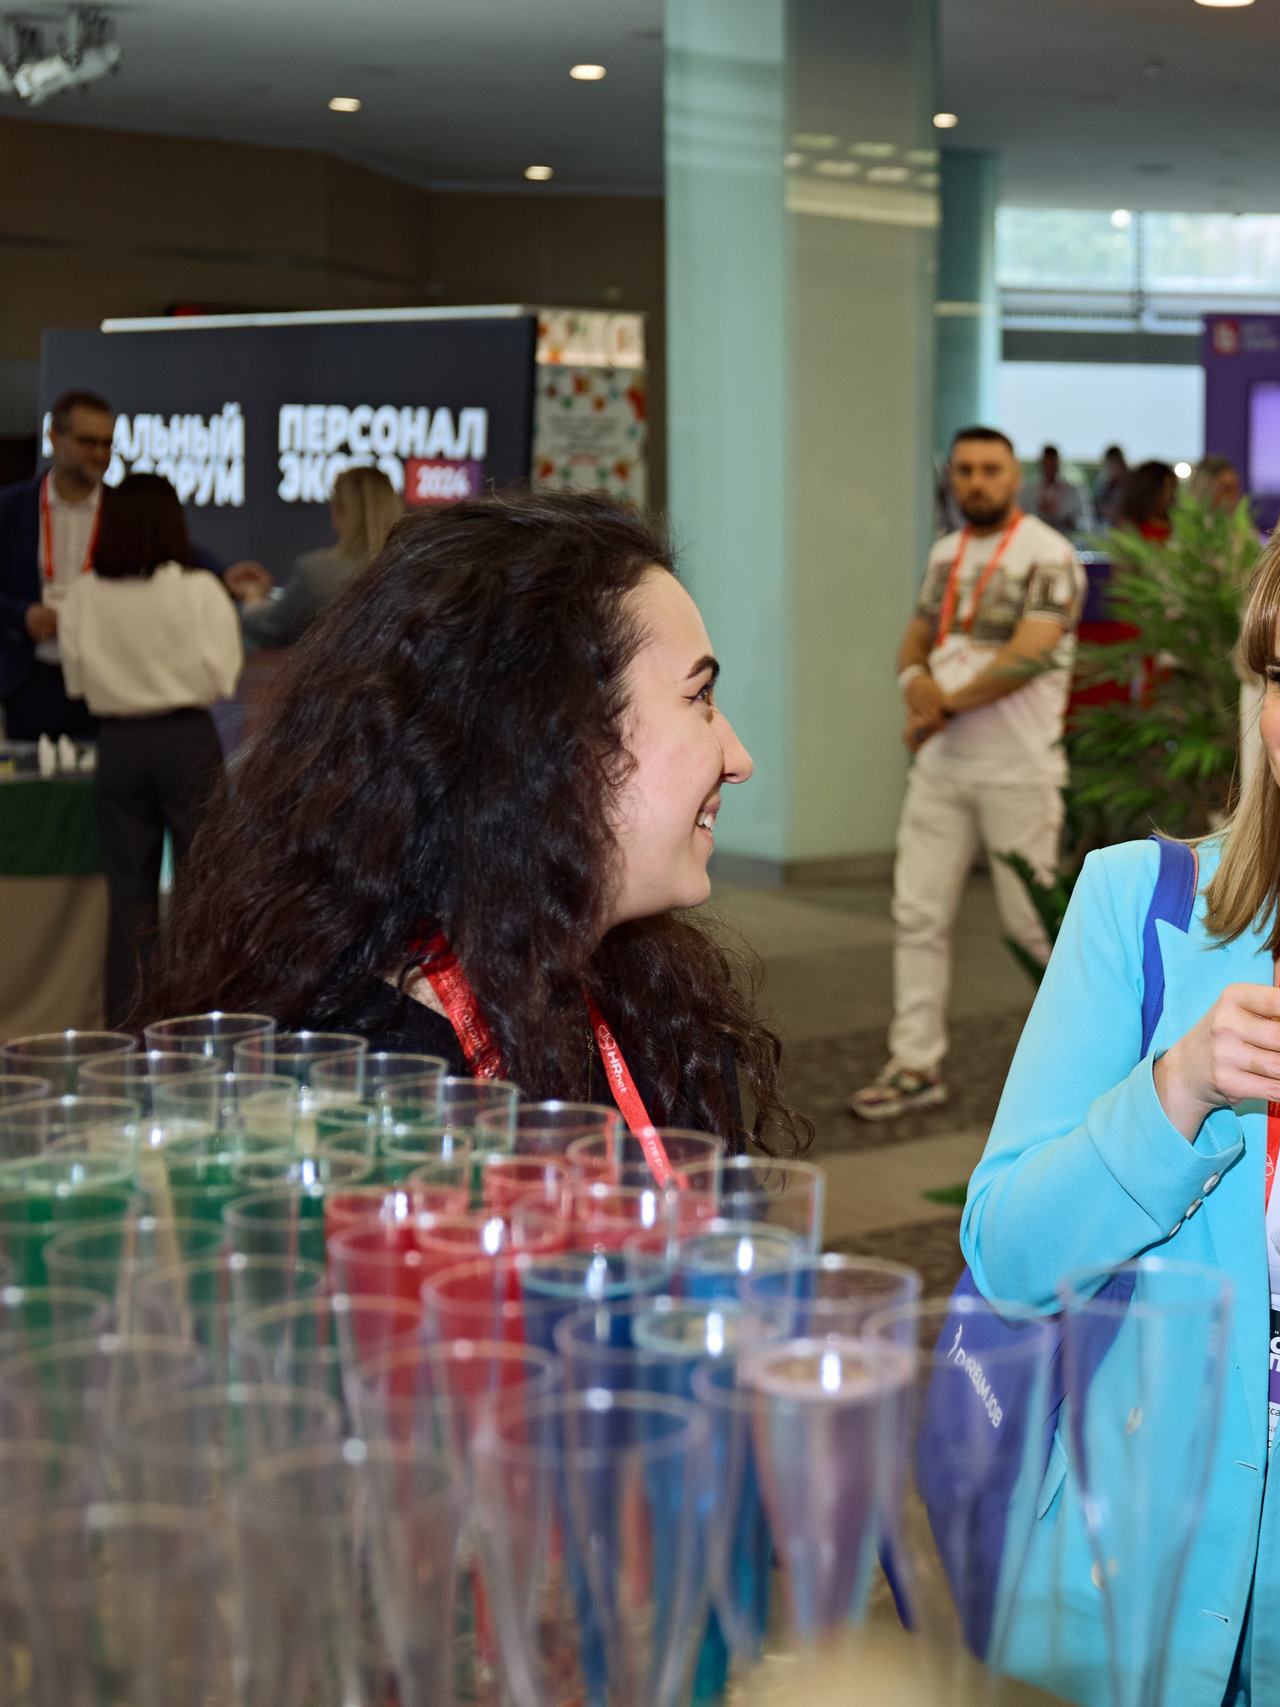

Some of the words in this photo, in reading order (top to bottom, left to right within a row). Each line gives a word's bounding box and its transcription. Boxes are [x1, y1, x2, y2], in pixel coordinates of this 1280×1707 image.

[279, 403, 489, 461] ПЕРСОНАЛ
[415, 464, 471, 500] 2024
[606, 1050, 627, 1094] HRnet
